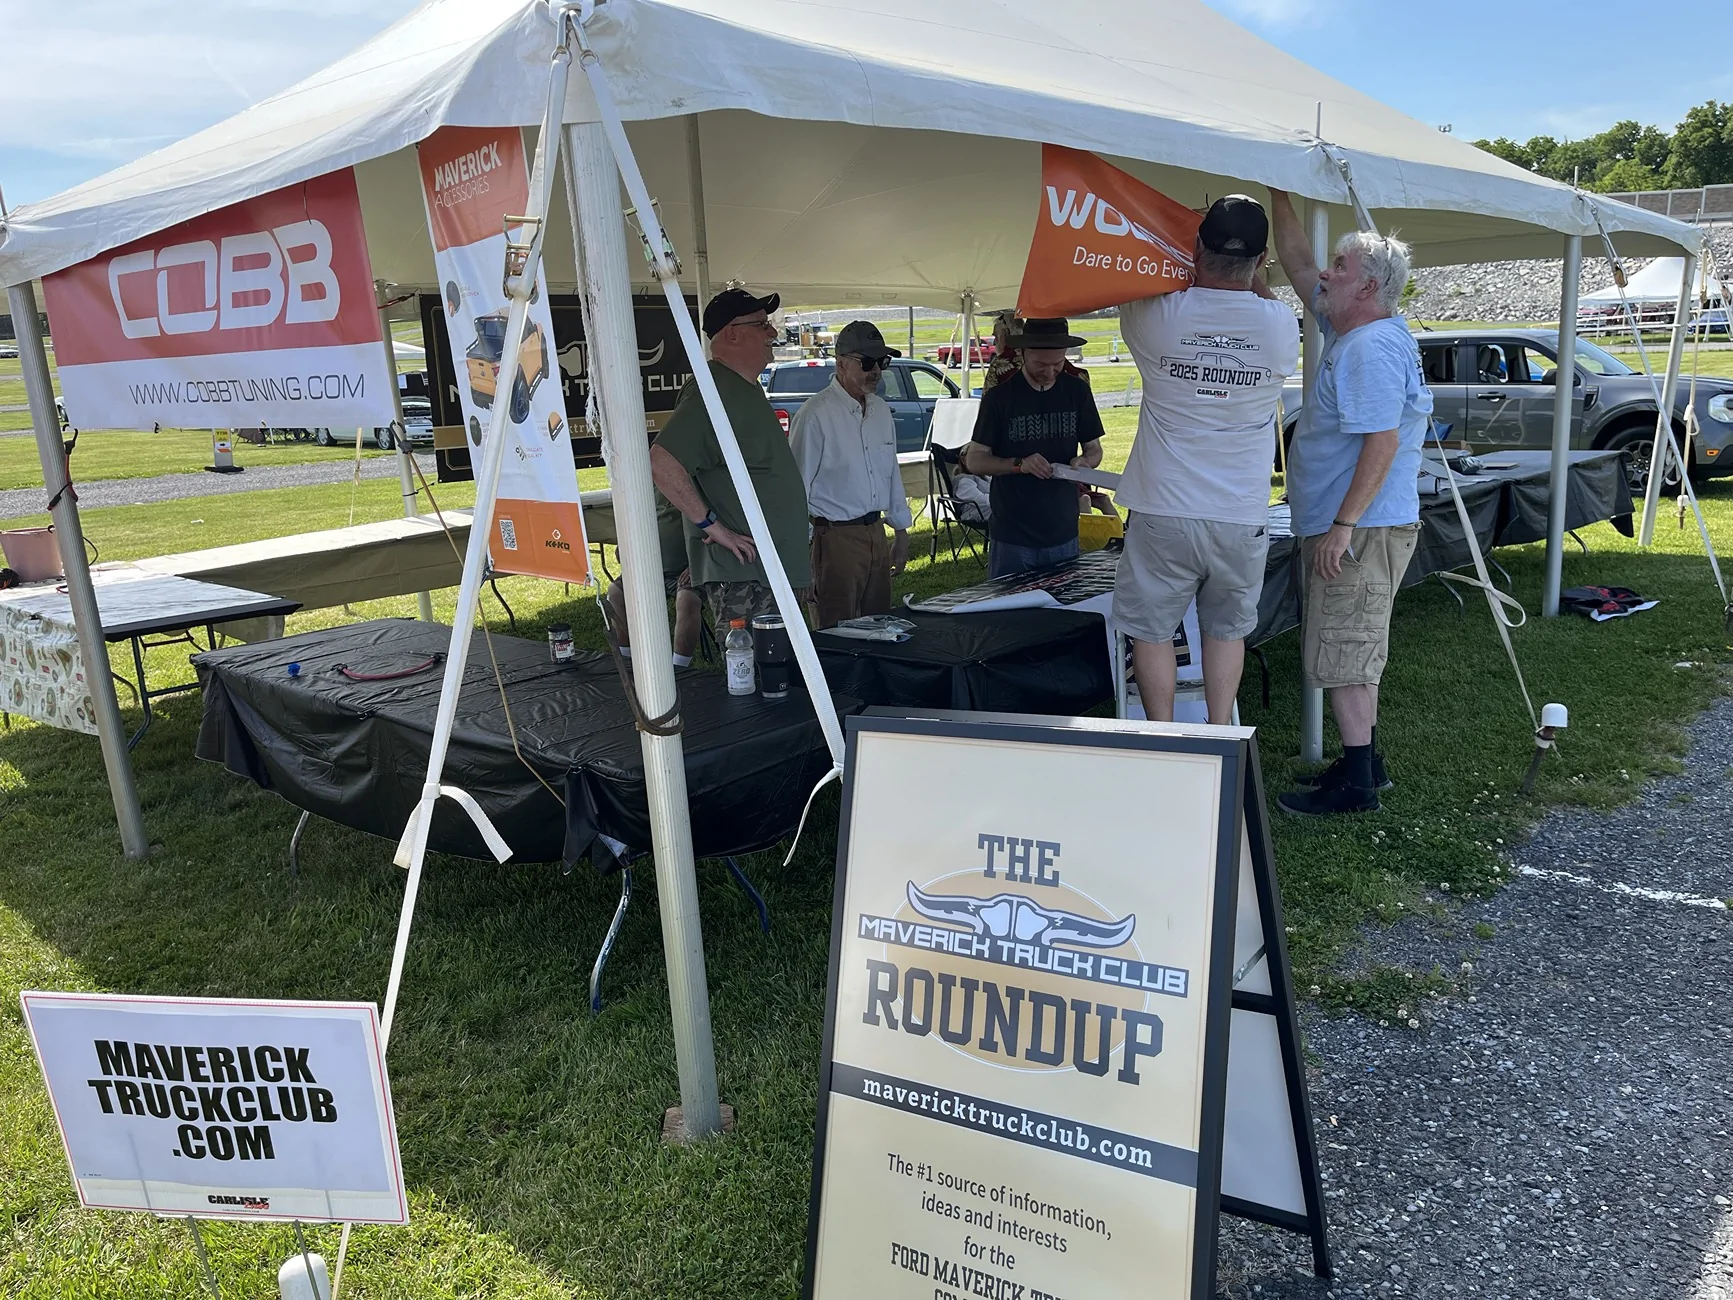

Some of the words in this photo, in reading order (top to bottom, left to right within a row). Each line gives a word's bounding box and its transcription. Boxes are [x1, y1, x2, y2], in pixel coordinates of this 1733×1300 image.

[434, 141, 502, 192] MAVERICK
[435, 175, 490, 209] ACCESSORIES
[108, 219, 341, 339] COBB
[1073, 246, 1112, 269] Dare
[1116, 253, 1132, 272] to
[1137, 256, 1157, 276] Go
[128, 374, 365, 405] WWW.COBBTUNING.COM
[1170, 363, 1199, 381] 2025
[1201, 367, 1261, 387] ROUNDUP
[978, 833, 1060, 887] THE
[861, 916, 990, 957] MAVERICK
[997, 940, 1095, 978] TRUCK
[1100, 959, 1187, 994] CLUB
[862, 958, 1163, 1086] ROUNDUP
[94, 1040, 317, 1083] MAVERICK
[87, 1080, 338, 1123] TRUCKCLUB
[862, 1078, 1153, 1168] mavericktruckclub.com
[172, 1124, 275, 1161] .COM
[207, 1195, 269, 1206] CARLISLE
[888, 1153, 913, 1177] The
[917, 1162, 933, 1183] #1
[937, 1171, 986, 1198] source
[990, 1185, 1006, 1204] of
[1009, 1188, 1112, 1240] information,
[921, 1191, 961, 1220] ideas
[964, 1208, 993, 1230] and
[997, 1213, 1067, 1253] interests
[891, 1242, 929, 1277] FORD
[933, 1256, 1025, 1300] MAVERICK
[964, 1236, 986, 1260] for
[990, 1246, 1015, 1270] the
